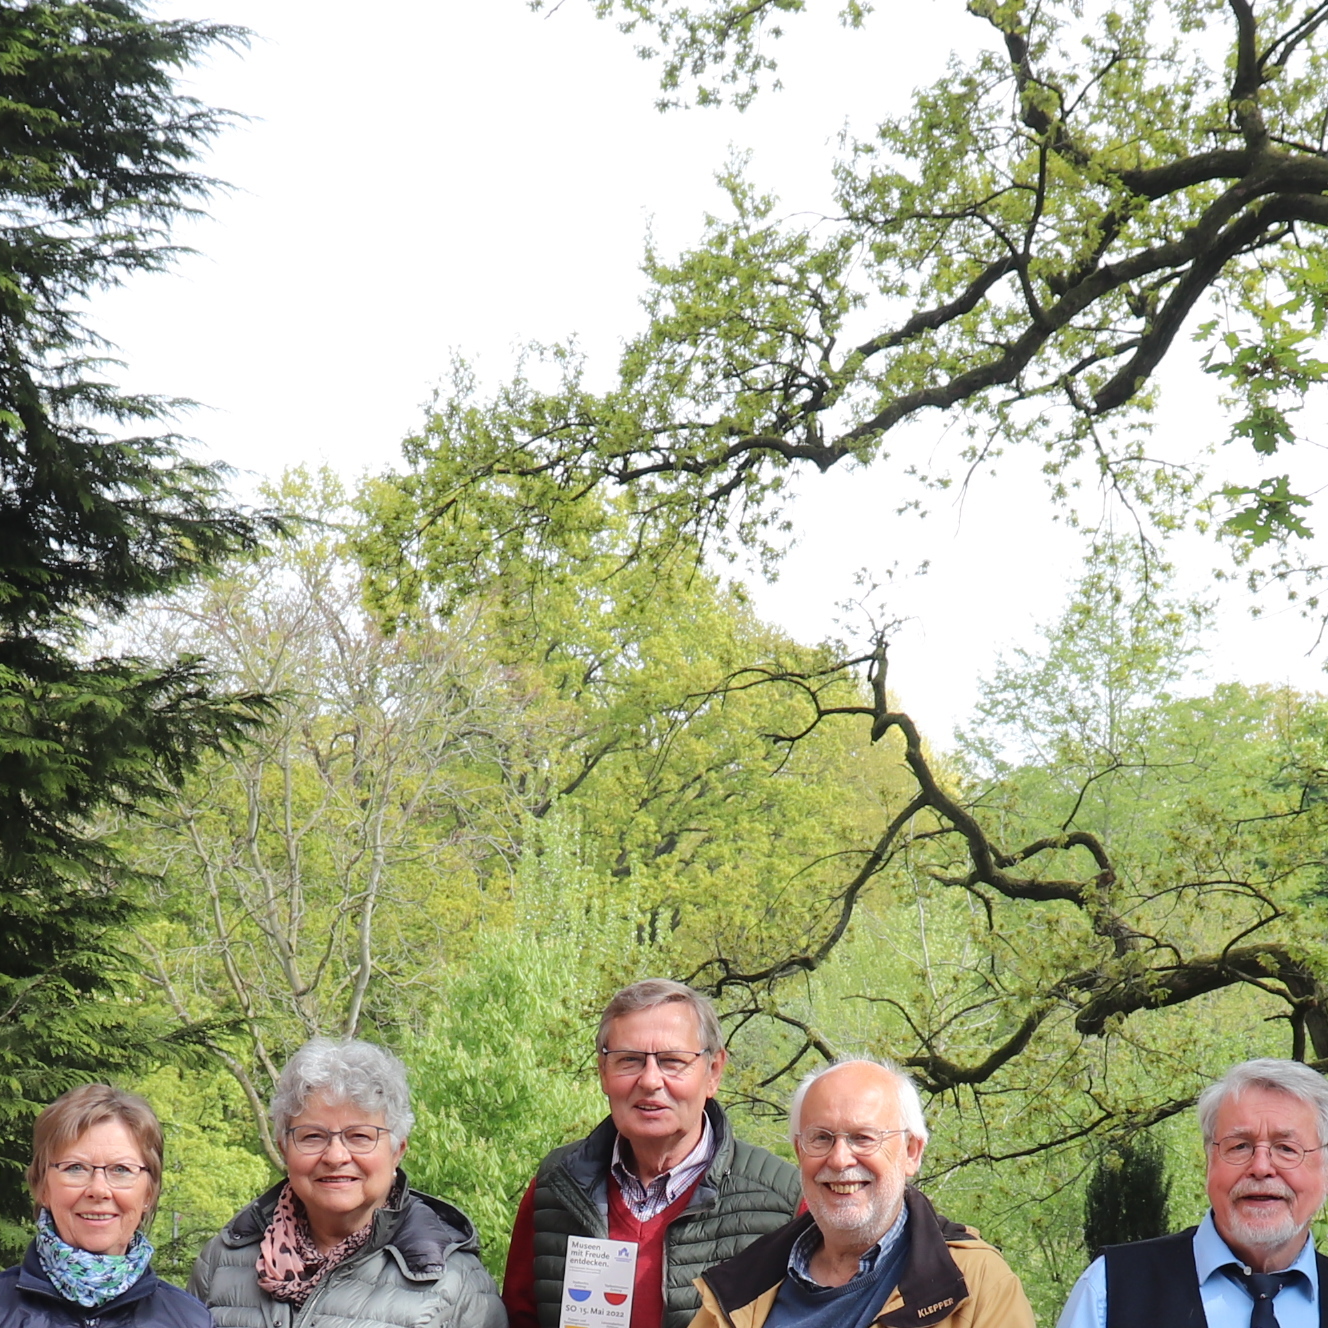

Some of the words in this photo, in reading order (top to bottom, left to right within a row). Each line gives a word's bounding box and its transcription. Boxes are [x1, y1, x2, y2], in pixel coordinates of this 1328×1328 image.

[572, 1241, 600, 1250] Museen
[585, 1251, 610, 1259] Freude
[570, 1256, 609, 1268] entdecken.
